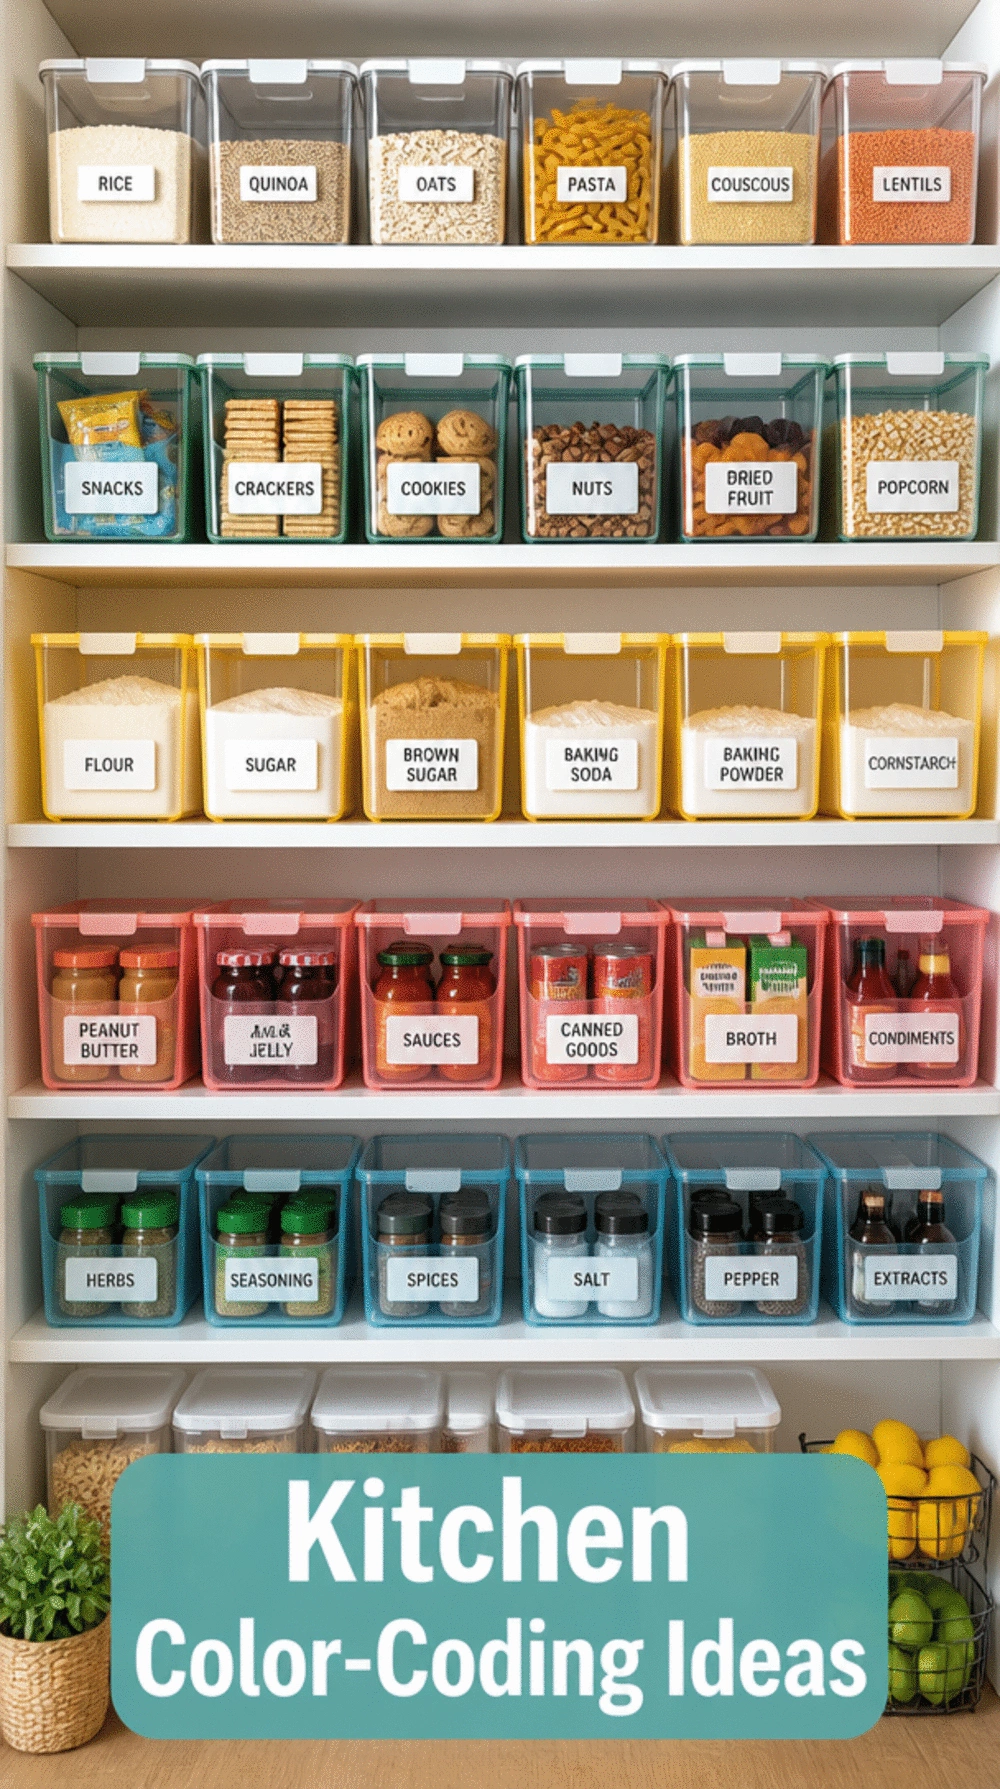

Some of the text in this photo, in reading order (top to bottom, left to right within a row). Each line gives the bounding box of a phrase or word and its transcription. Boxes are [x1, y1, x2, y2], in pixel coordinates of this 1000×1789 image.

[98, 175, 133, 192] RICE
[249, 176, 309, 193] QUINOA
[416, 176, 457, 192] OATS
[568, 176, 616, 192] PASTA
[711, 176, 790, 192] COUSCOUS
[883, 176, 942, 192] LENTILS
[727, 469, 773, 486] DRIED
[81, 481, 144, 496] SNACKS
[234, 481, 315, 496] CRACKERS
[400, 481, 466, 496] COOKIES
[572, 480, 613, 496] NUTS
[878, 479, 949, 495] POPCORN
[728, 490, 774, 506] FRUIT
[403, 747, 460, 763] BROWN
[85, 757, 134, 772] FLOUR
[245, 757, 297, 773] SUGAR
[407, 767, 457, 782] SUGAR
[571, 767, 612, 782] SODA
[720, 766, 784, 782] POWDER
[79, 1022, 139, 1038] PEANUT
[560, 1022, 624, 1037] CANNED
[403, 1032, 461, 1048] SAUCES
[726, 1031, 777, 1047] BROTH
[869, 1031, 956, 1046] CONDIMENTS
[81, 1042, 139, 1059] BUTTER
[249, 1042, 293, 1058] JELLY
[565, 1041, 618, 1058] GOODS
[86, 1272, 135, 1288] HERBS
[231, 1272, 313, 1288] SEASONING
[407, 1272, 459, 1288] SPICES
[573, 1272, 609, 1287] SALT
[724, 1271, 779, 1287] PEPPER
[874, 1270, 948, 1286] EXTRACTS
